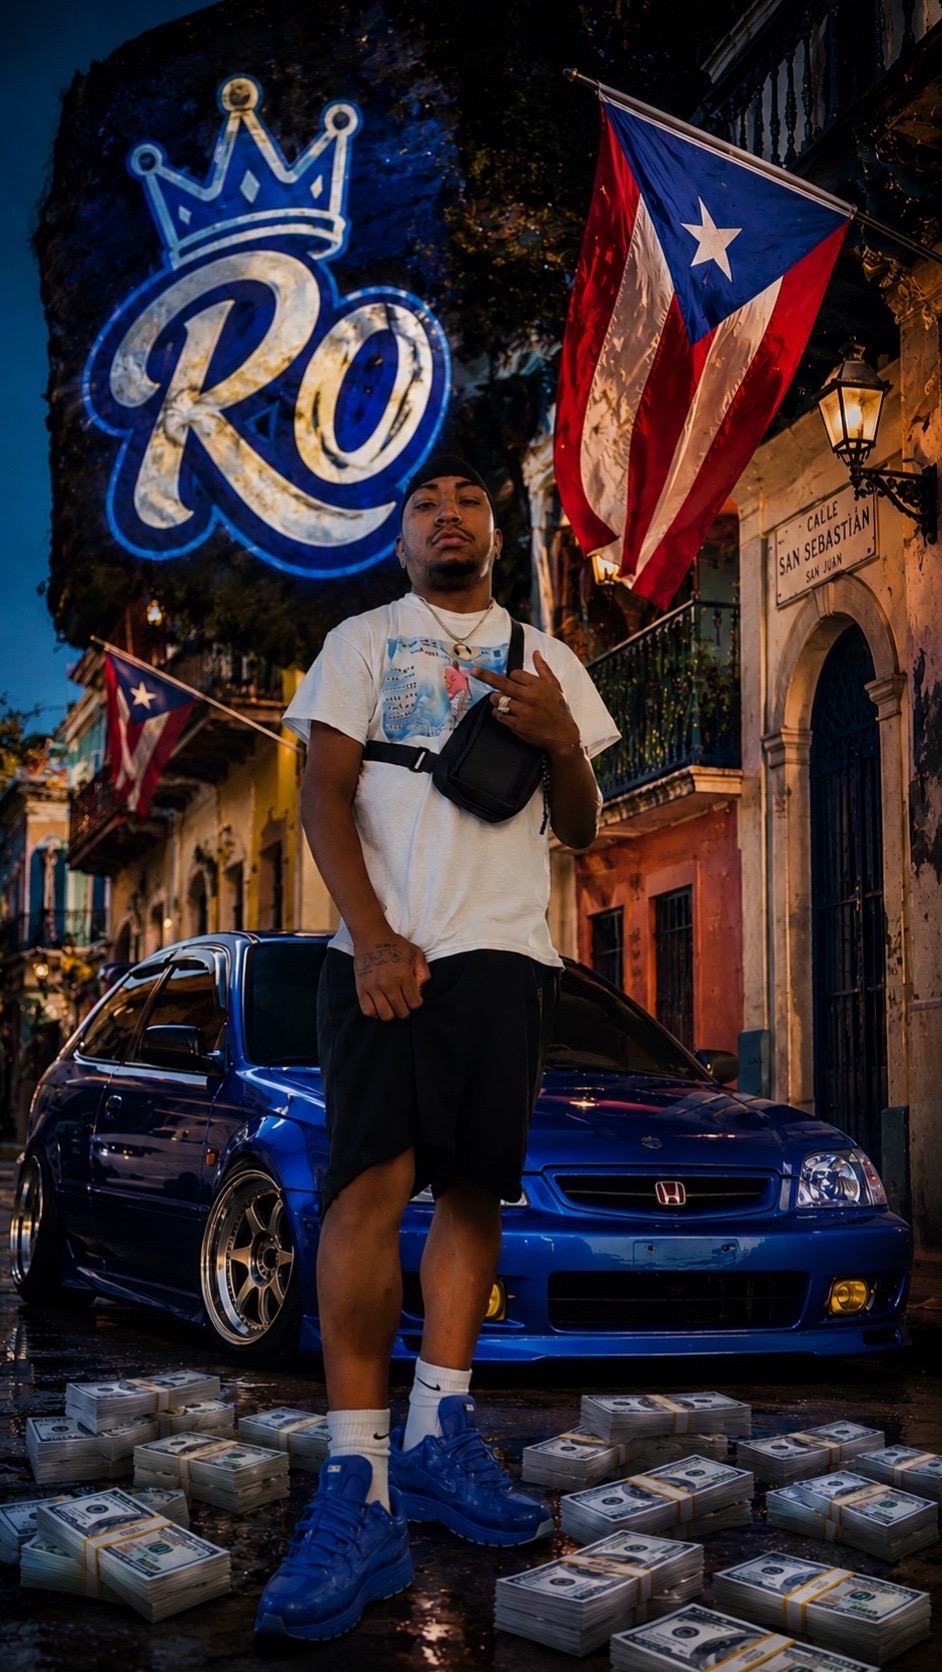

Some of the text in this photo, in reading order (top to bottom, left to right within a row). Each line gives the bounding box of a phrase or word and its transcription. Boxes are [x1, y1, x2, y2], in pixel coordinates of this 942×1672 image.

[807, 500, 838, 532] CALLE
[779, 506, 870, 576] SAN SEBASTIÁN
[806, 552, 843, 583] SAN JUAN
